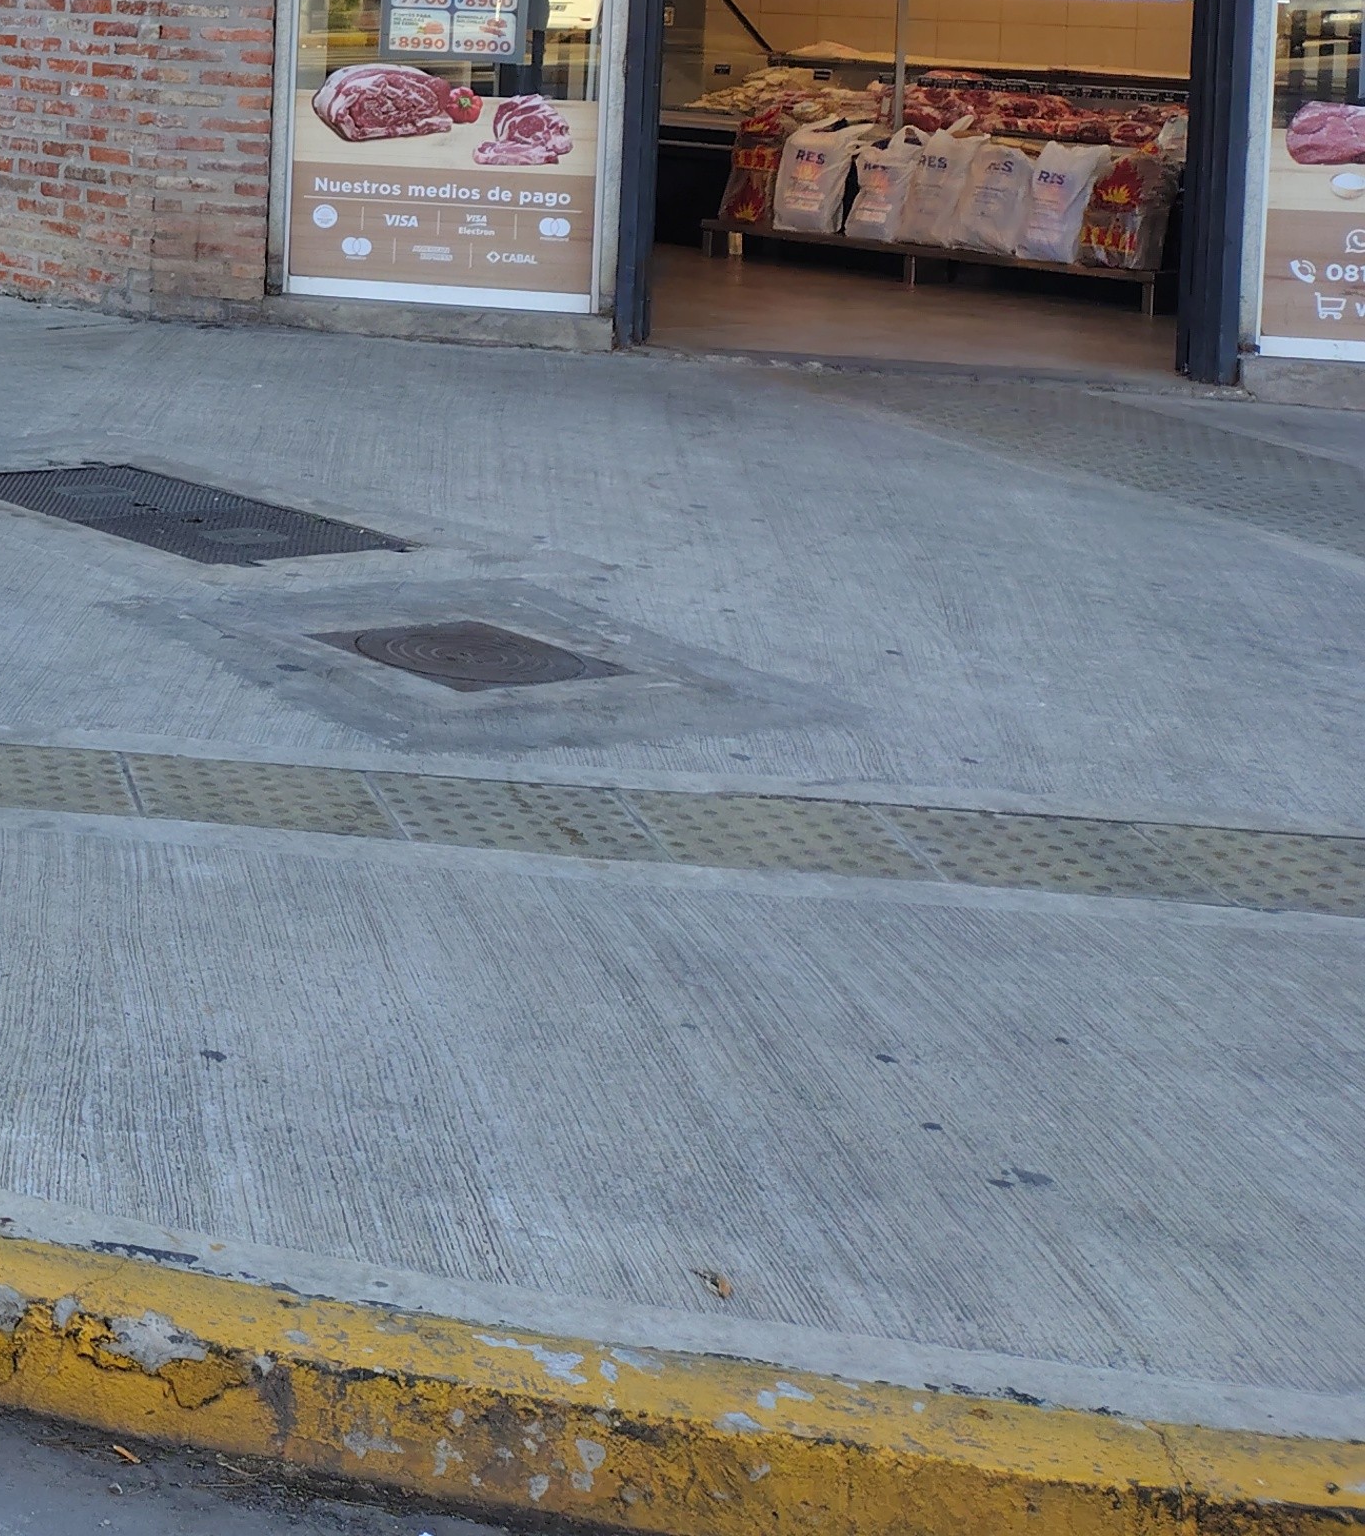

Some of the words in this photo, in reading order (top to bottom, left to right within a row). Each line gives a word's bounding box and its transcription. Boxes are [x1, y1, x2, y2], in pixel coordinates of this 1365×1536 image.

[796, 148, 825, 166] RES
[314, 177, 401, 196] Nuestros
[408, 182, 481, 201] medios
[487, 185, 512, 202] de
[519, 191, 572, 207] pago
[383, 214, 419, 228] VISA
[465, 214, 487, 223] VISA
[458, 226, 495, 237] Electron
[502, 254, 538, 265] CABAL
